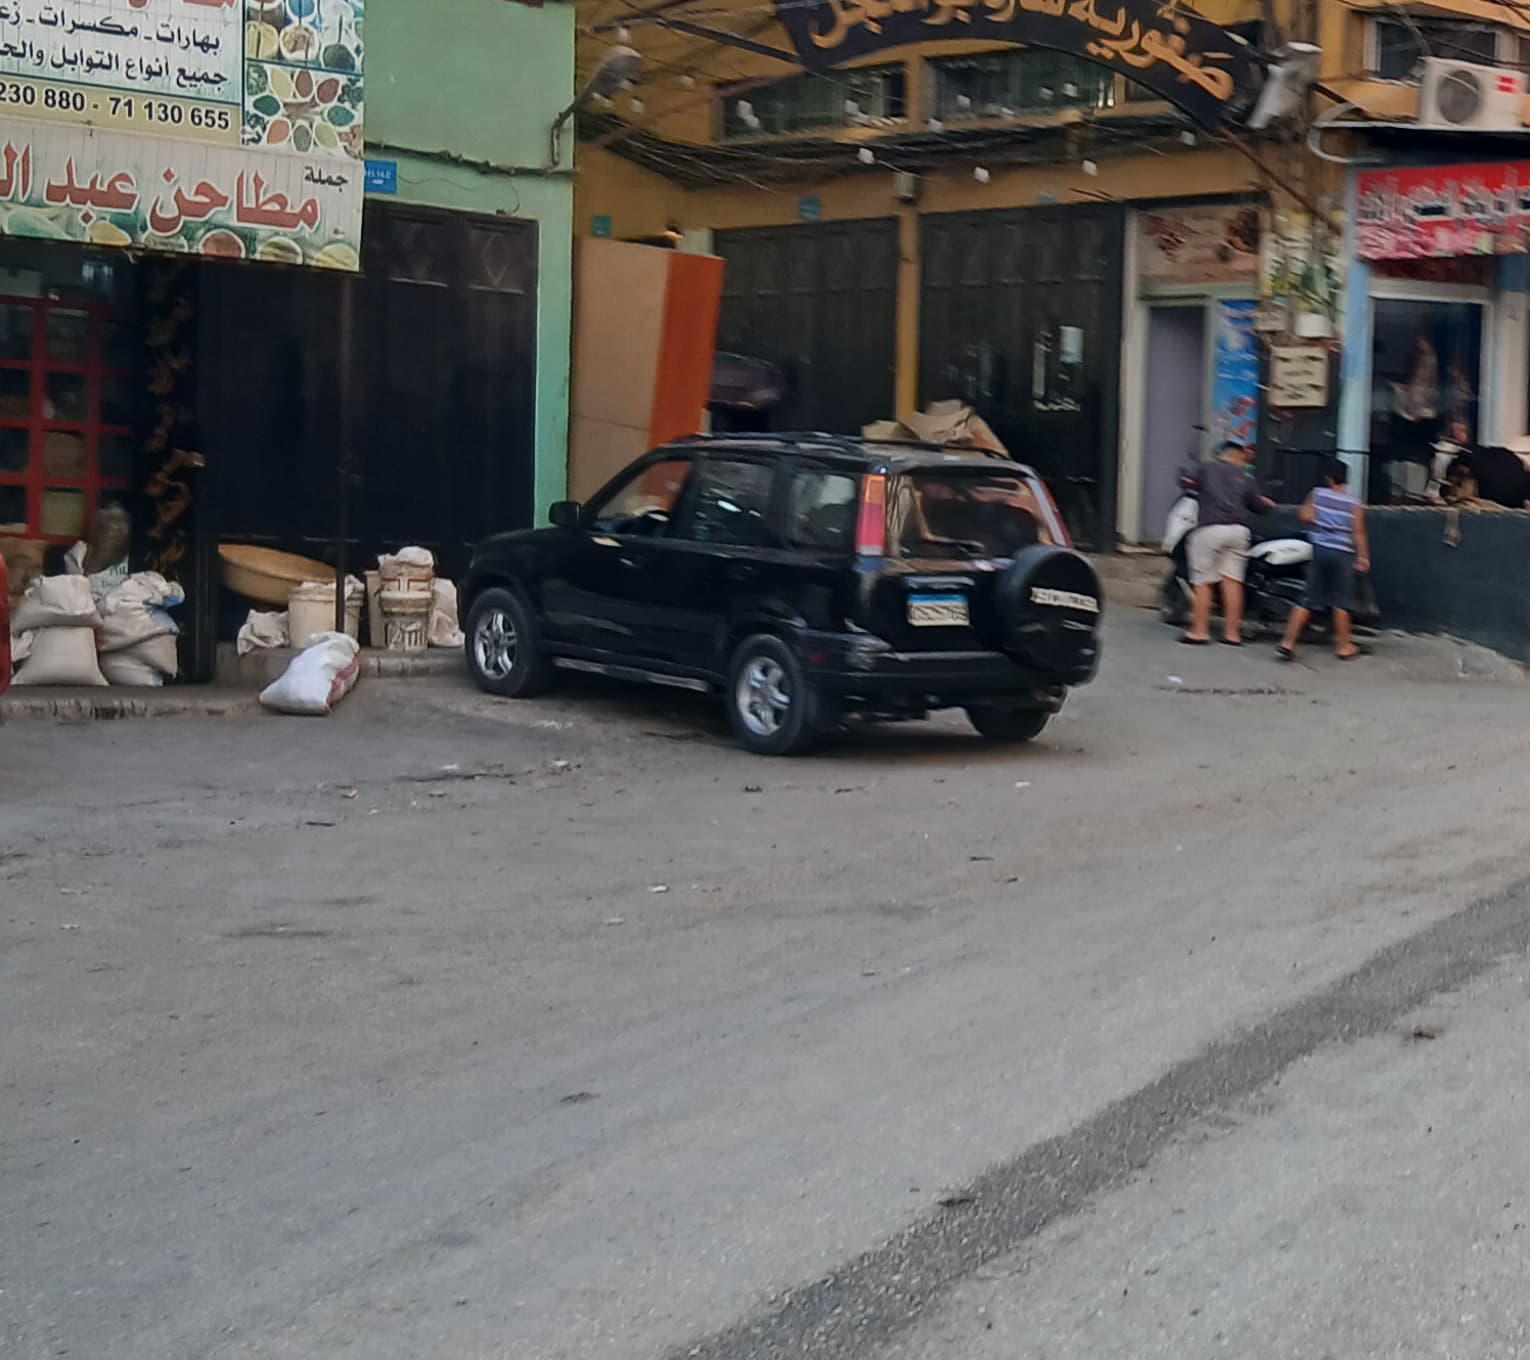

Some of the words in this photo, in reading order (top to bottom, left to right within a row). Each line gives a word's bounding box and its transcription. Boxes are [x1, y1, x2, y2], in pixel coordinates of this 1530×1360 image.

[38, 5, 139, 39] مكسرات
[156, 23, 220, 56] بهارات
[50, 45, 119, 73] التوابل
[176, 67, 228, 92] جميع
[44, 88, 86, 112] 880
[109, 96, 133, 118] 71
[144, 101, 183, 124] 130
[190, 107, 230, 130] 655
[46, 155, 138, 224] عبد
[304, 165, 349, 192] جملة
[150, 167, 320, 234] مطاحن
